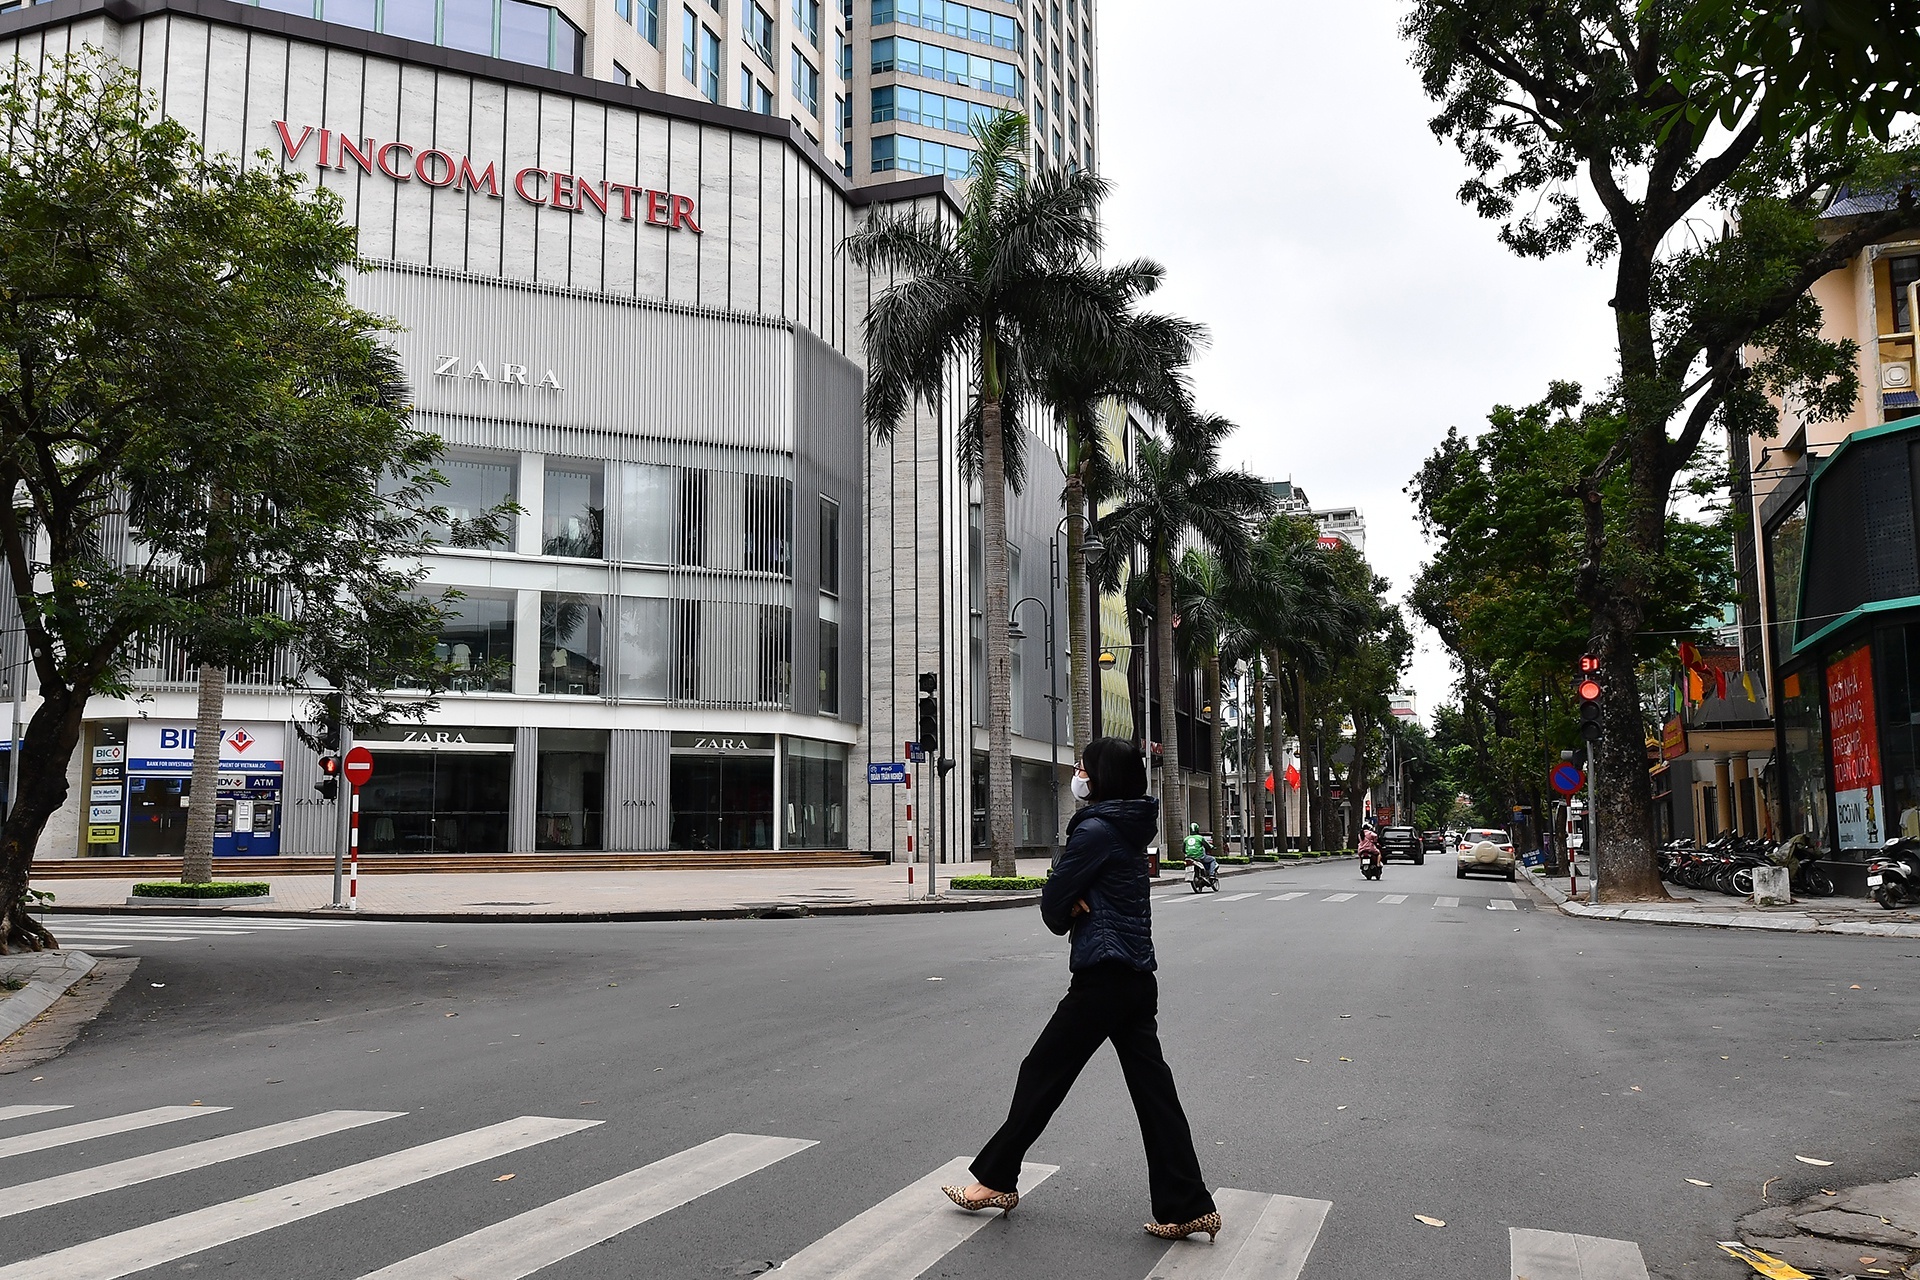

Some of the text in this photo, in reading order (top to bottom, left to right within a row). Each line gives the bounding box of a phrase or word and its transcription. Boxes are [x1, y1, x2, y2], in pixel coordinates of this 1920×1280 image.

[271, 119, 704, 234] VINCOM CENTER
[433, 354, 565, 391] ZARA
[1582, 658, 1597, 670] 31
[403, 731, 467, 743] ZARA
[694, 738, 749, 749] ZARA
[217, 778, 233, 786] IDV
[253, 778, 274, 786] ATM
